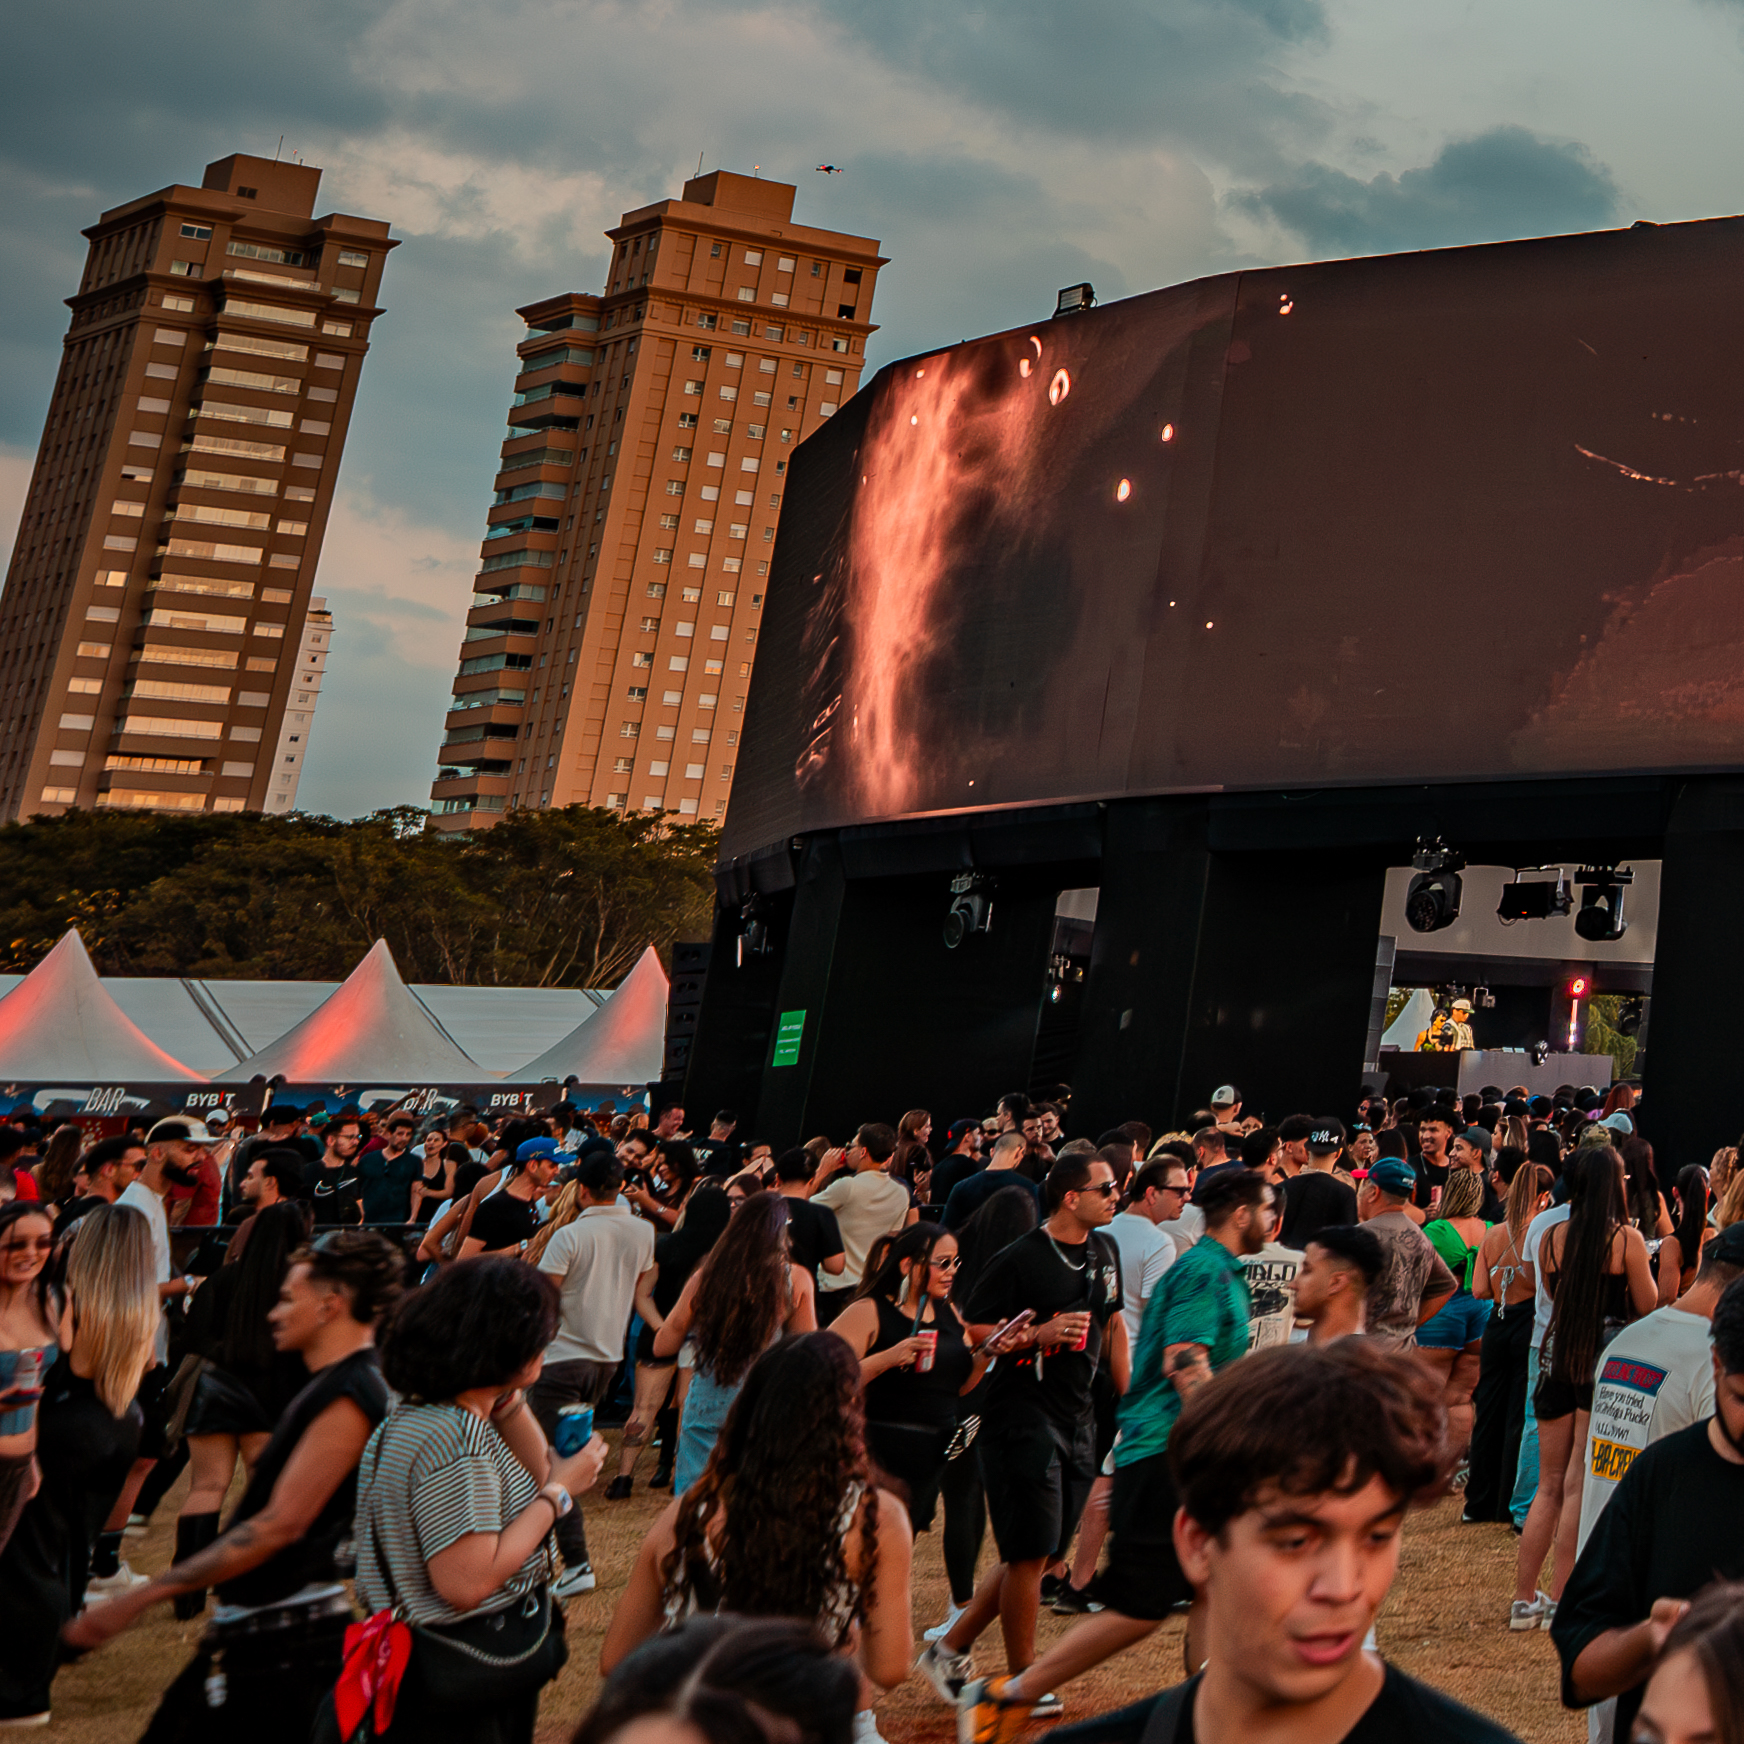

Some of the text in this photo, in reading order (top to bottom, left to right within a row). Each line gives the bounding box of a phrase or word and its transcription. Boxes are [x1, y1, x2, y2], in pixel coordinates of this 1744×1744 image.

[84, 1087, 126, 1113] BAR
[186, 1090, 236, 1107] BYBIT
[490, 1091, 534, 1107] BYBIT
